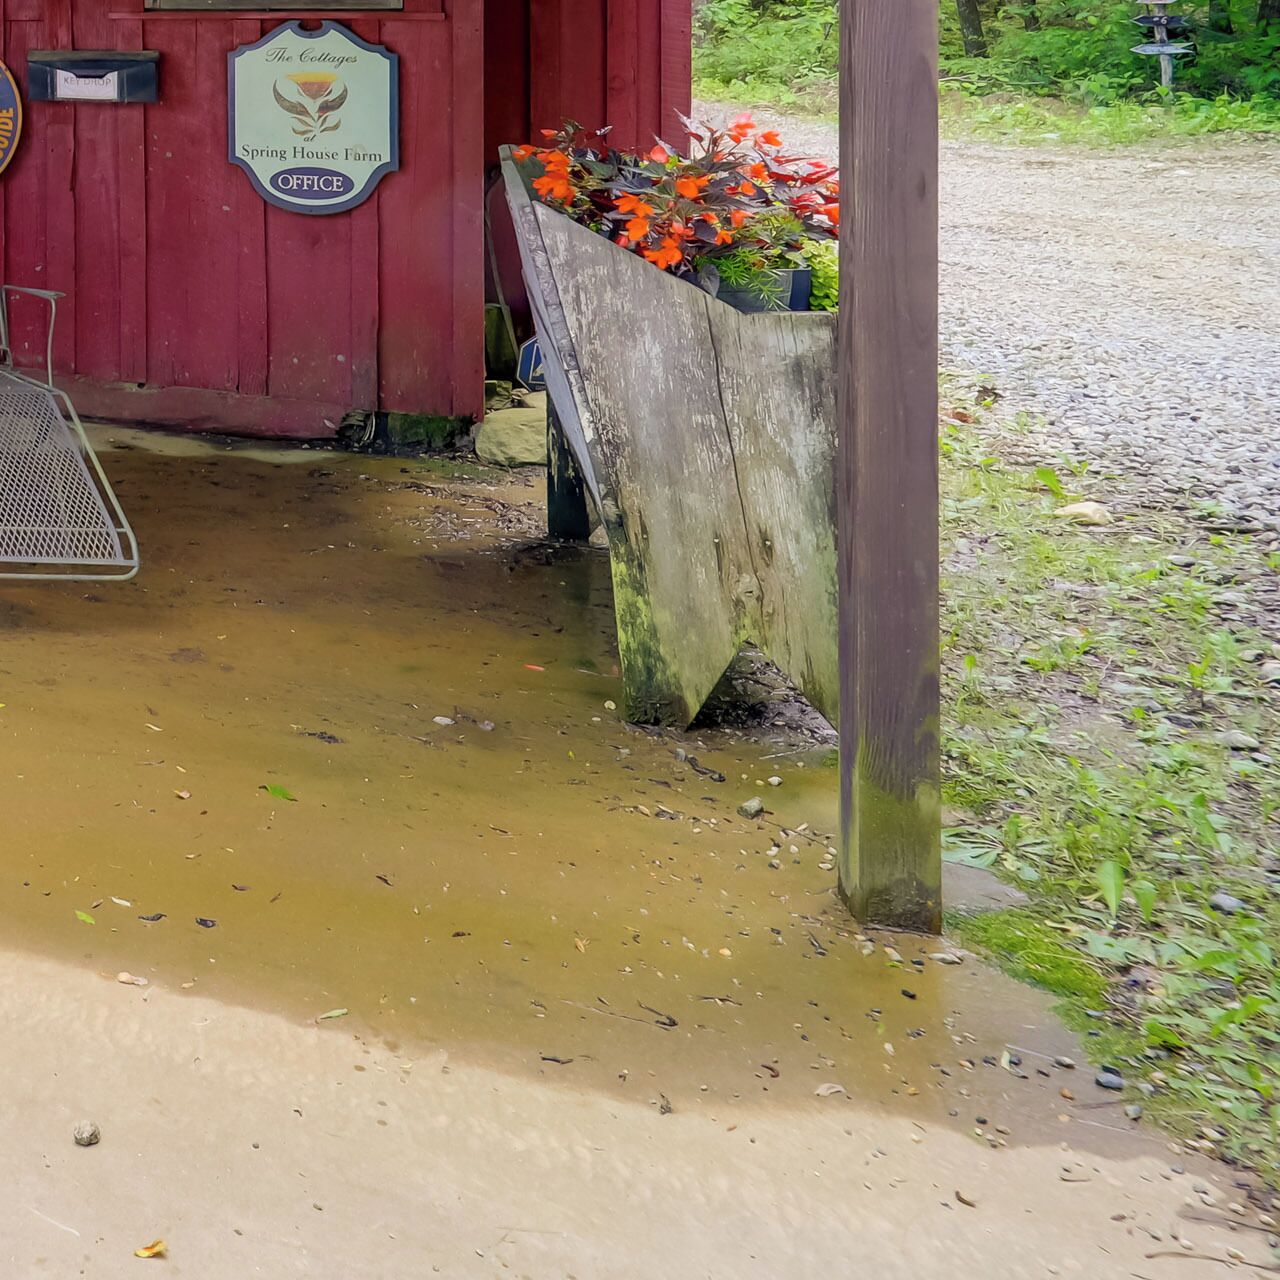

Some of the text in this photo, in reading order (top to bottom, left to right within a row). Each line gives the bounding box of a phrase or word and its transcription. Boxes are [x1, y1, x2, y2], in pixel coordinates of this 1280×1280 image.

[265, 47, 358, 69] The Cottages
[63, 76, 112, 87] KEY DROP
[304, 134, 316, 142] at
[242, 144, 382, 162] Spring House Farm
[278, 174, 343, 192] OFFICE
